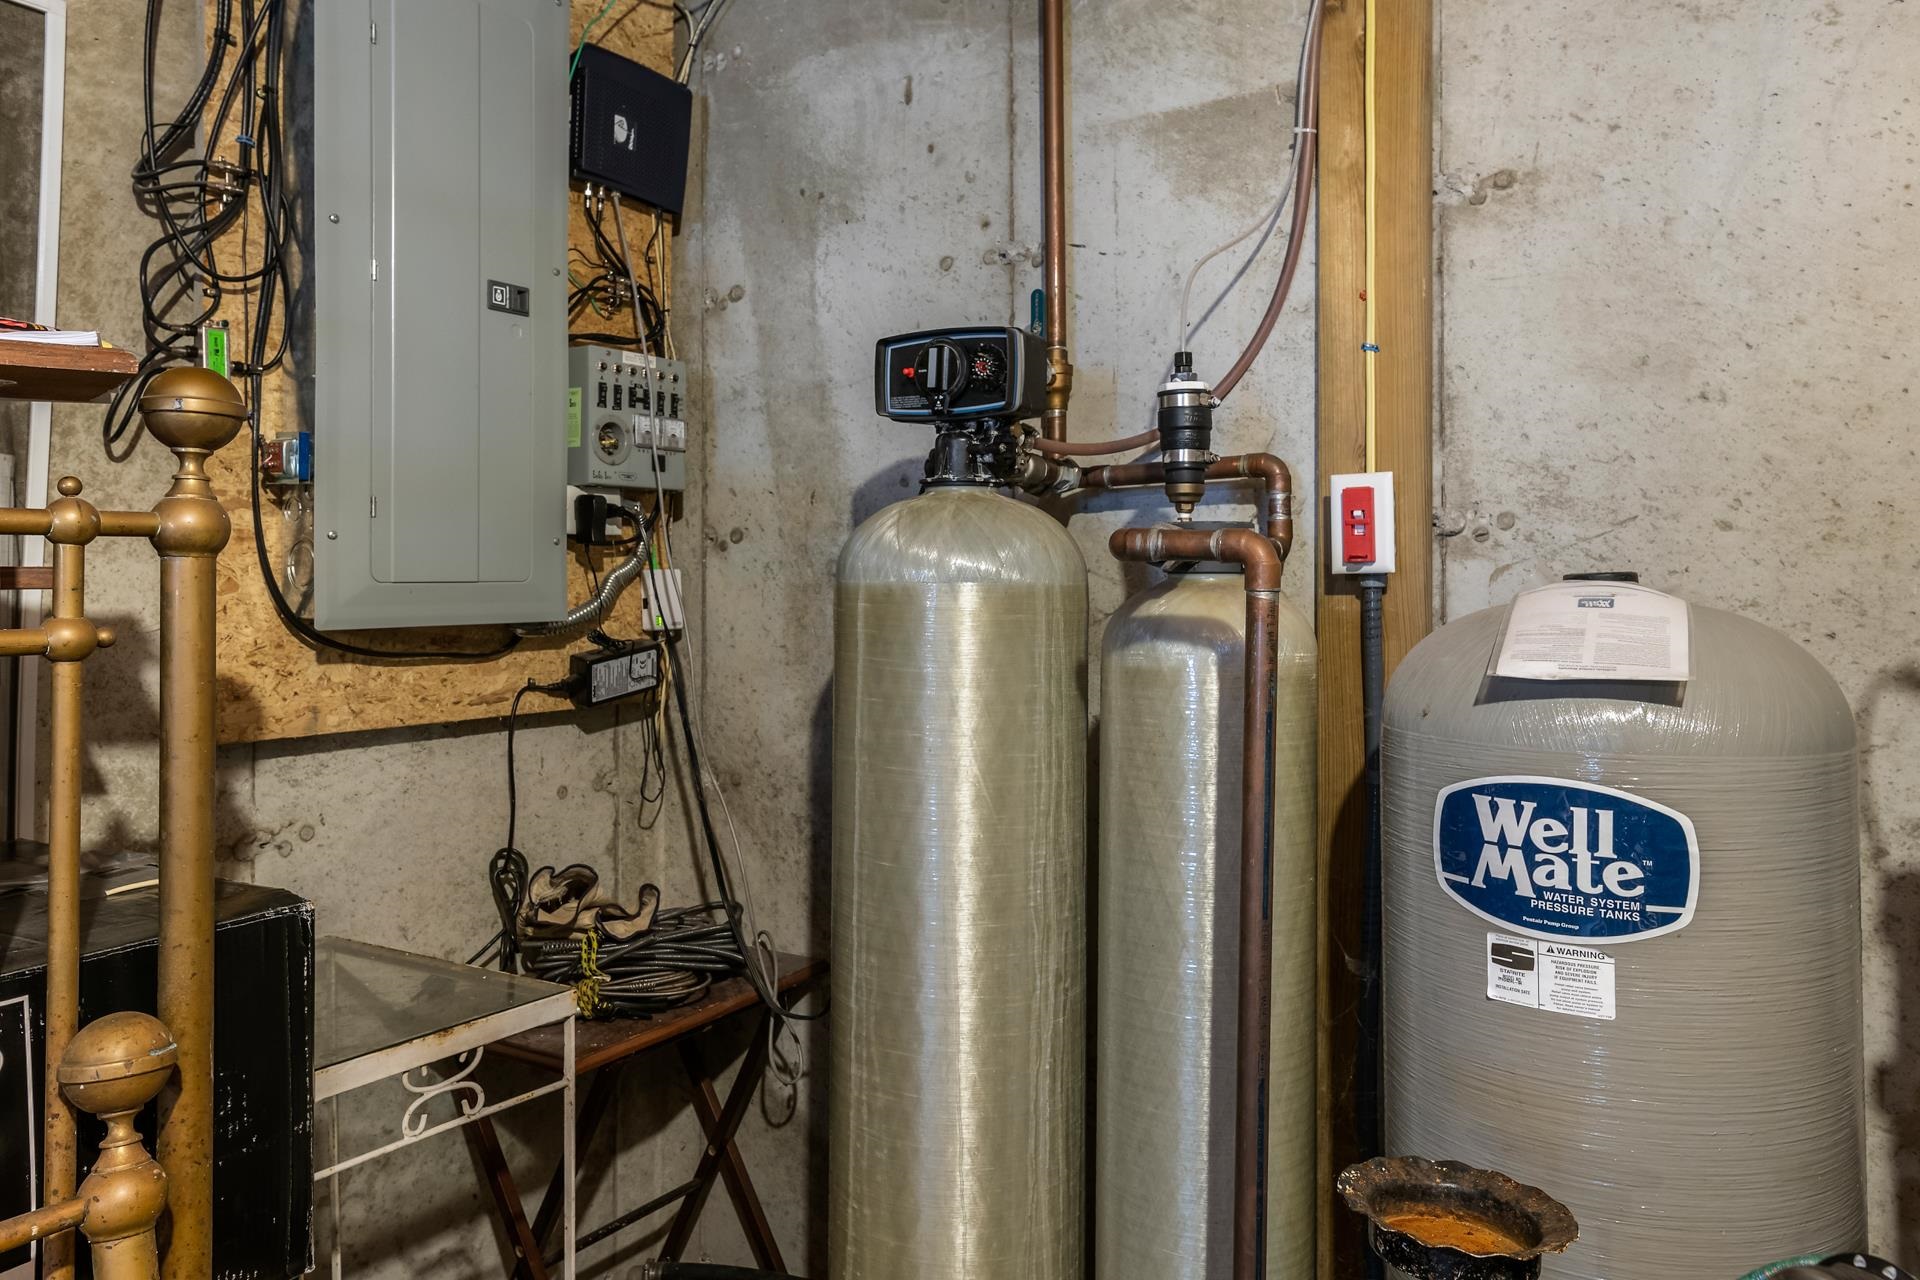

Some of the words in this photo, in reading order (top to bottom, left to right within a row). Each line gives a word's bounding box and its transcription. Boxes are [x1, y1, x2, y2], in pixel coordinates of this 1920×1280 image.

[1472, 793, 1617, 859] Well
[1471, 843, 1645, 898] Mate
[1530, 899, 1594, 917] PRESSURE
[1599, 908, 1640, 922] TANKS
[1543, 891, 1584, 905] WATER
[1590, 897, 1640, 911] SYSTEM
[1522, 915, 1543, 924] Pentair
[1543, 919, 1560, 928] Pump
[1561, 922, 1579, 930] Group
[1556, 947, 1605, 960] WARNING
